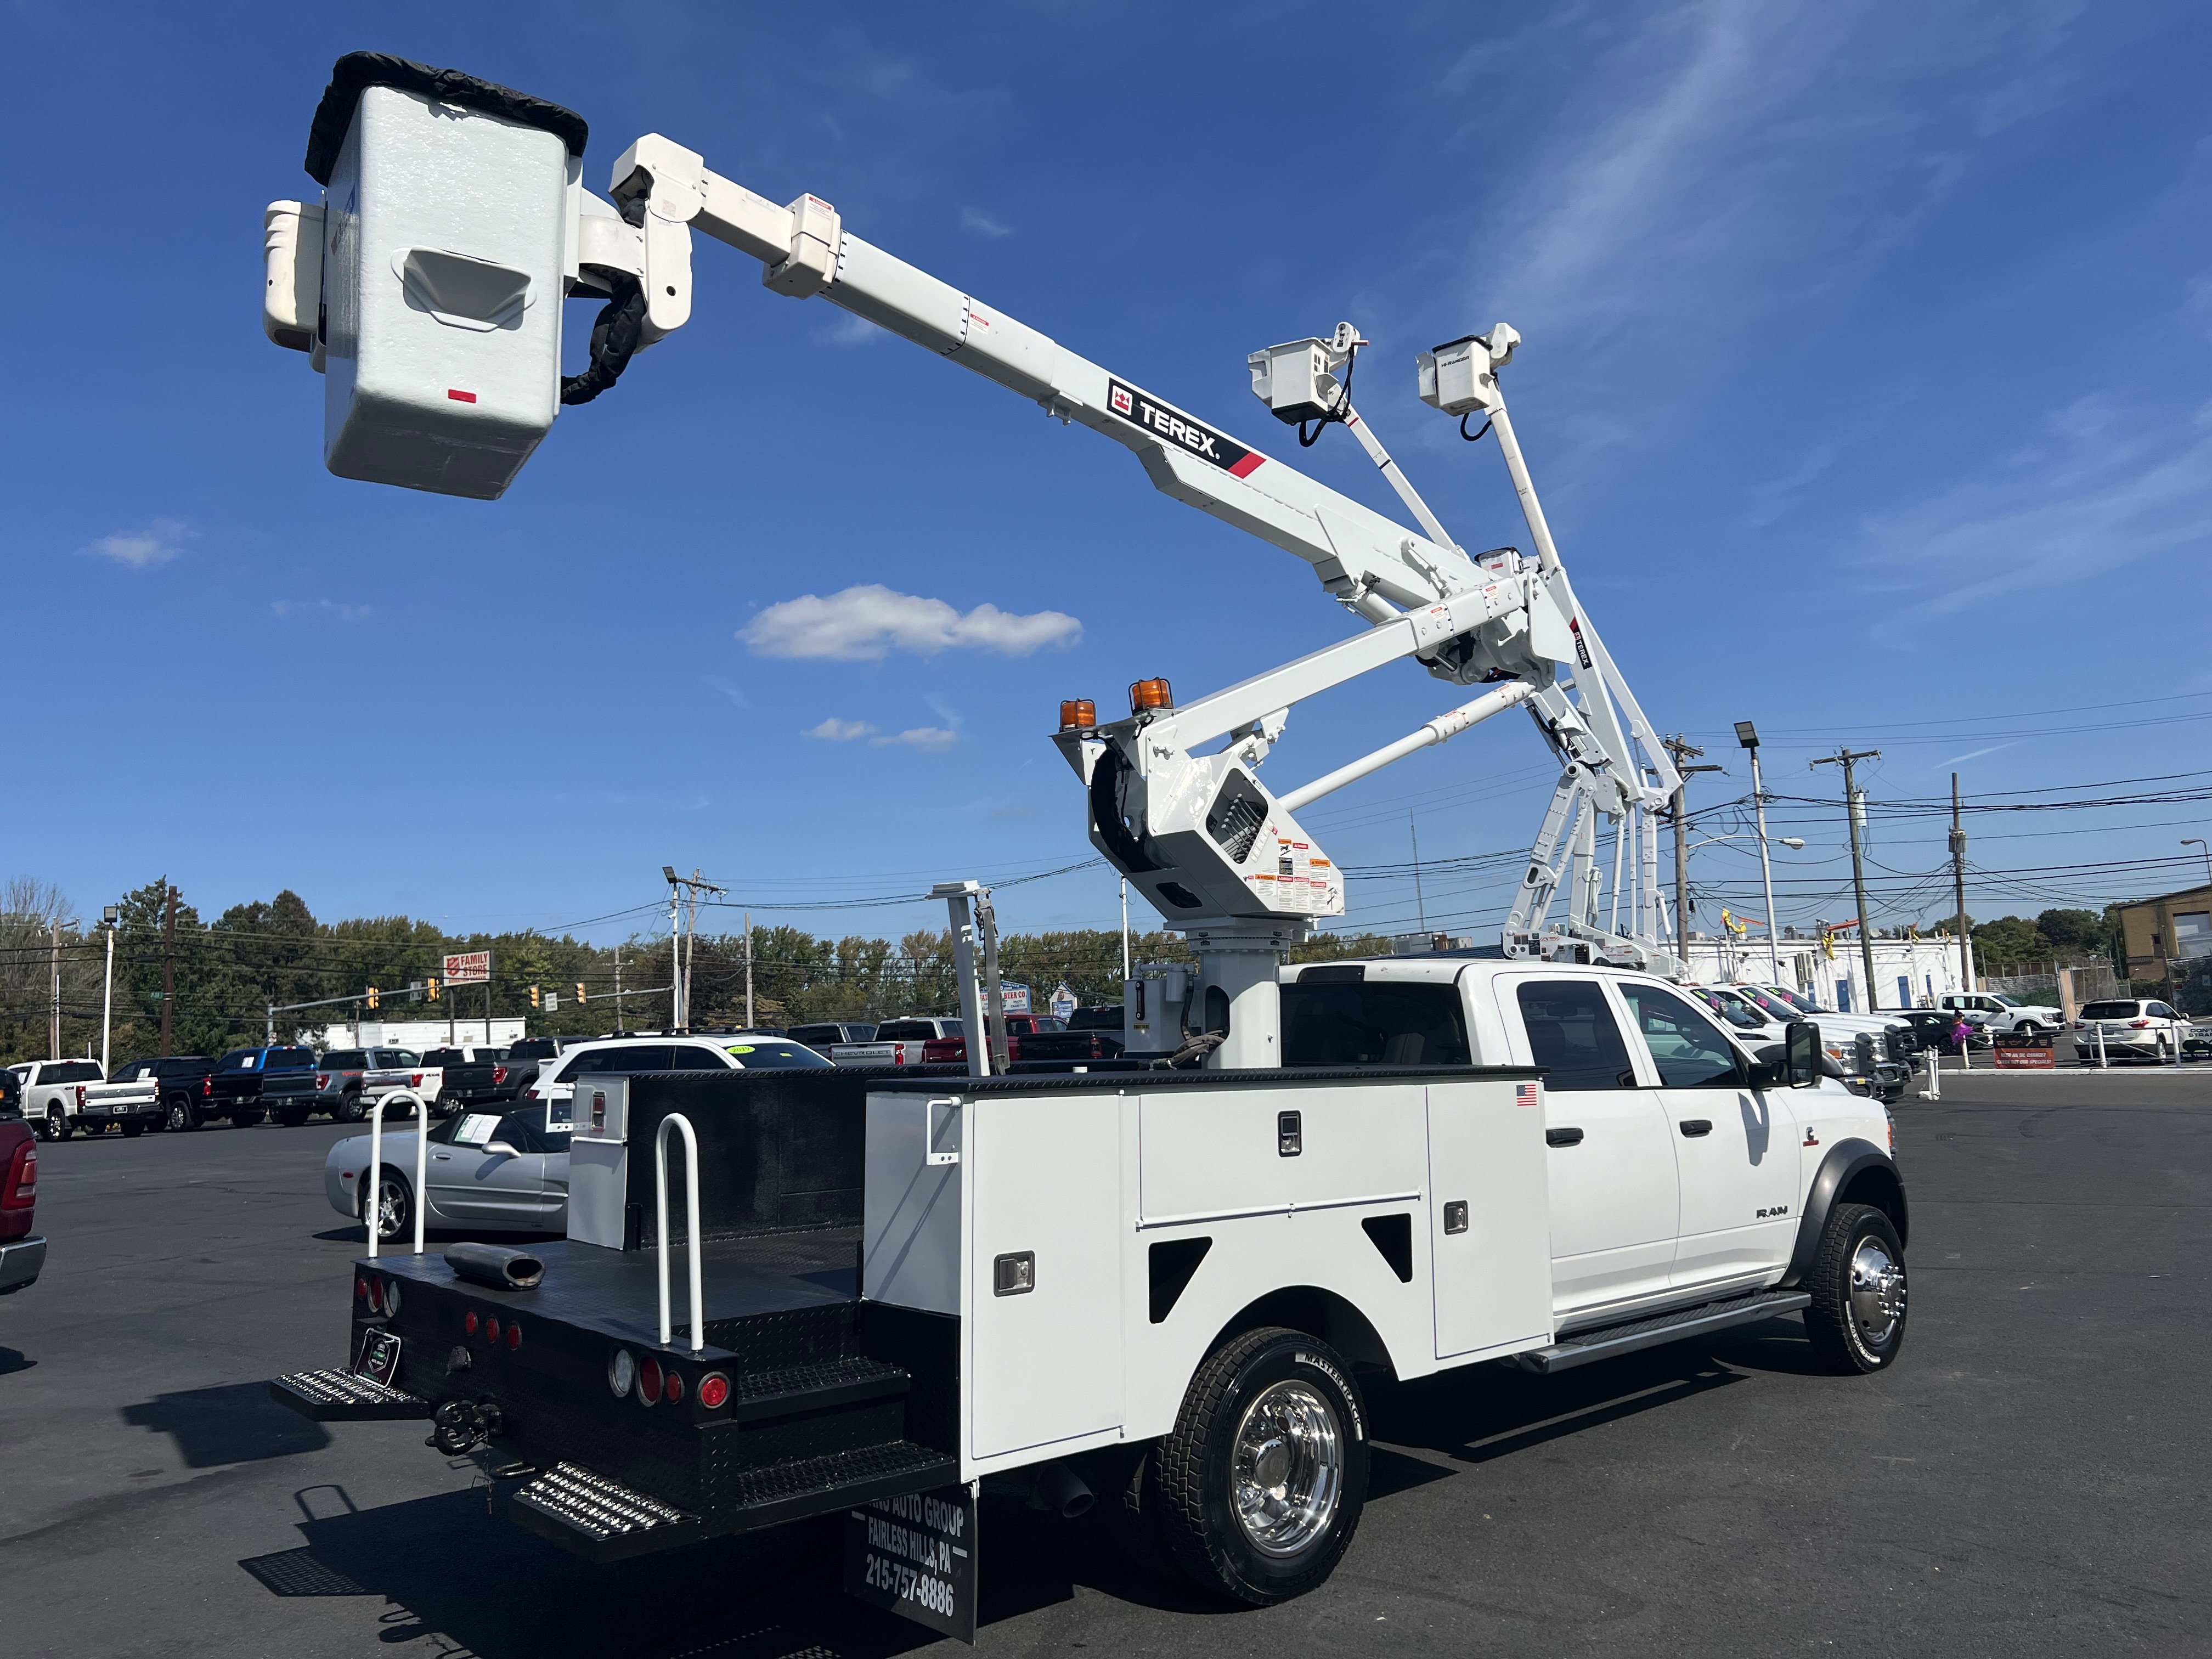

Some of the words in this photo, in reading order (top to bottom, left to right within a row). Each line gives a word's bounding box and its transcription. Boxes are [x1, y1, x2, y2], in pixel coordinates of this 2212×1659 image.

[1139, 400, 1215, 458] TEREX
[1576, 640, 1589, 664] TEREX
[461, 953, 488, 966] FAMILY
[463, 964, 487, 977] STORE
[1756, 1205, 1788, 1219] RAM
[1305, 1353, 1361, 1427] MASTERTRACK
[893, 1493, 922, 1523] AUTO
[924, 1496, 964, 1537] GROUP
[868, 1516, 907, 1558] FAIRLESS
[910, 1531, 938, 1575] HILLS,
[939, 1541, 951, 1575] PA
[866, 1553, 954, 1617] 215-757-8886
